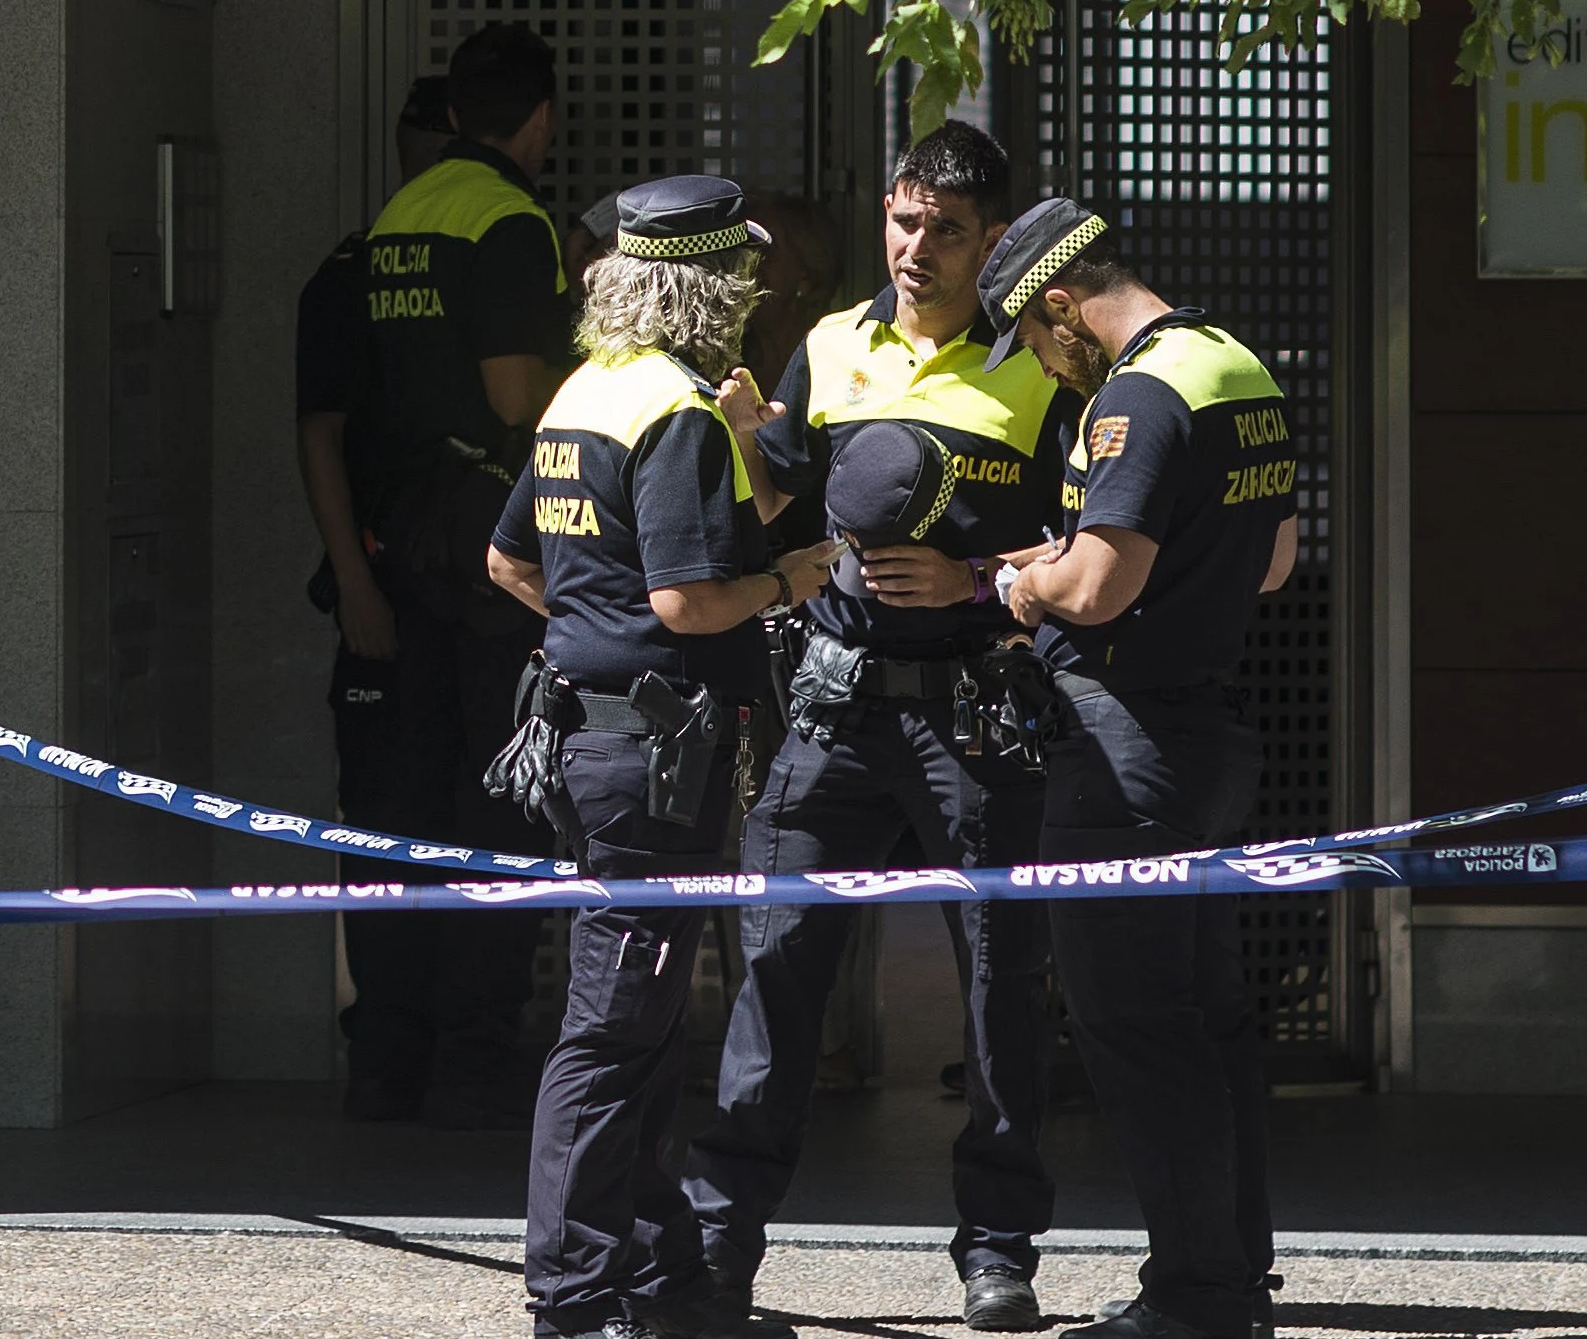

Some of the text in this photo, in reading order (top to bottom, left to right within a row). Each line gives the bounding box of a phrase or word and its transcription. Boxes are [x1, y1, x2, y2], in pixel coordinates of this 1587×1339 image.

[1507, 16, 1587, 65] edi
[952, 454, 1022, 485] OLICIA
[1434, 843, 1525, 859] Zaragoza
[1010, 859, 1190, 887] NO PASAR
[1464, 859, 1524, 872] POLICIA
